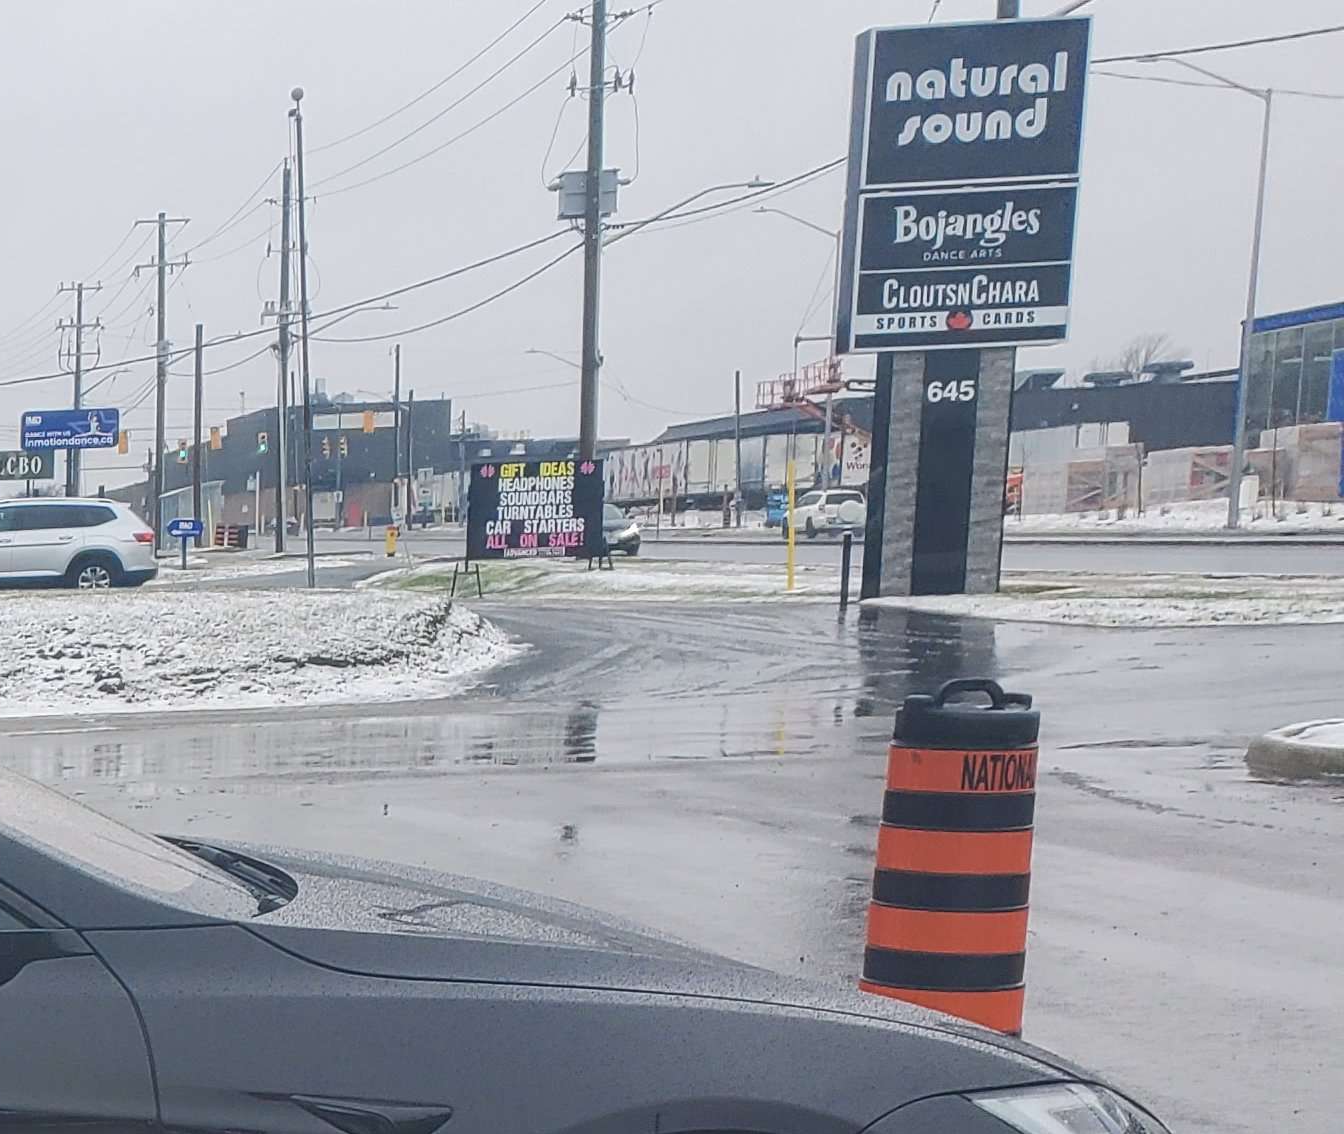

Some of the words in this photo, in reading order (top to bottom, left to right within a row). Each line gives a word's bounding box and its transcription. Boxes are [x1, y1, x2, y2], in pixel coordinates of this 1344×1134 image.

[885, 51, 1068, 101] natural
[897, 97, 1048, 146] sound
[893, 201, 1041, 250] Bojangles
[923, 250, 965, 261] DANCE
[970, 248, 1003, 259] ARTS
[876, 315, 938, 330] SPORTS
[982, 310, 1036, 325] CARDS
[927, 379, 976, 403] 645
[500, 462, 526, 477] GIFT
[540, 461, 575, 476] IDEAS
[498, 476, 575, 492] HEADPHONES
[499, 491, 572, 506] SOUNDBARS
[497, 505, 574, 520] TURNTABLES
[486, 520, 512, 535] CAR
[524, 518, 585, 533] STARTERS
[486, 535, 508, 549] ALL
[520, 533, 538, 547] ON
[548, 532, 584, 547] SALE!
